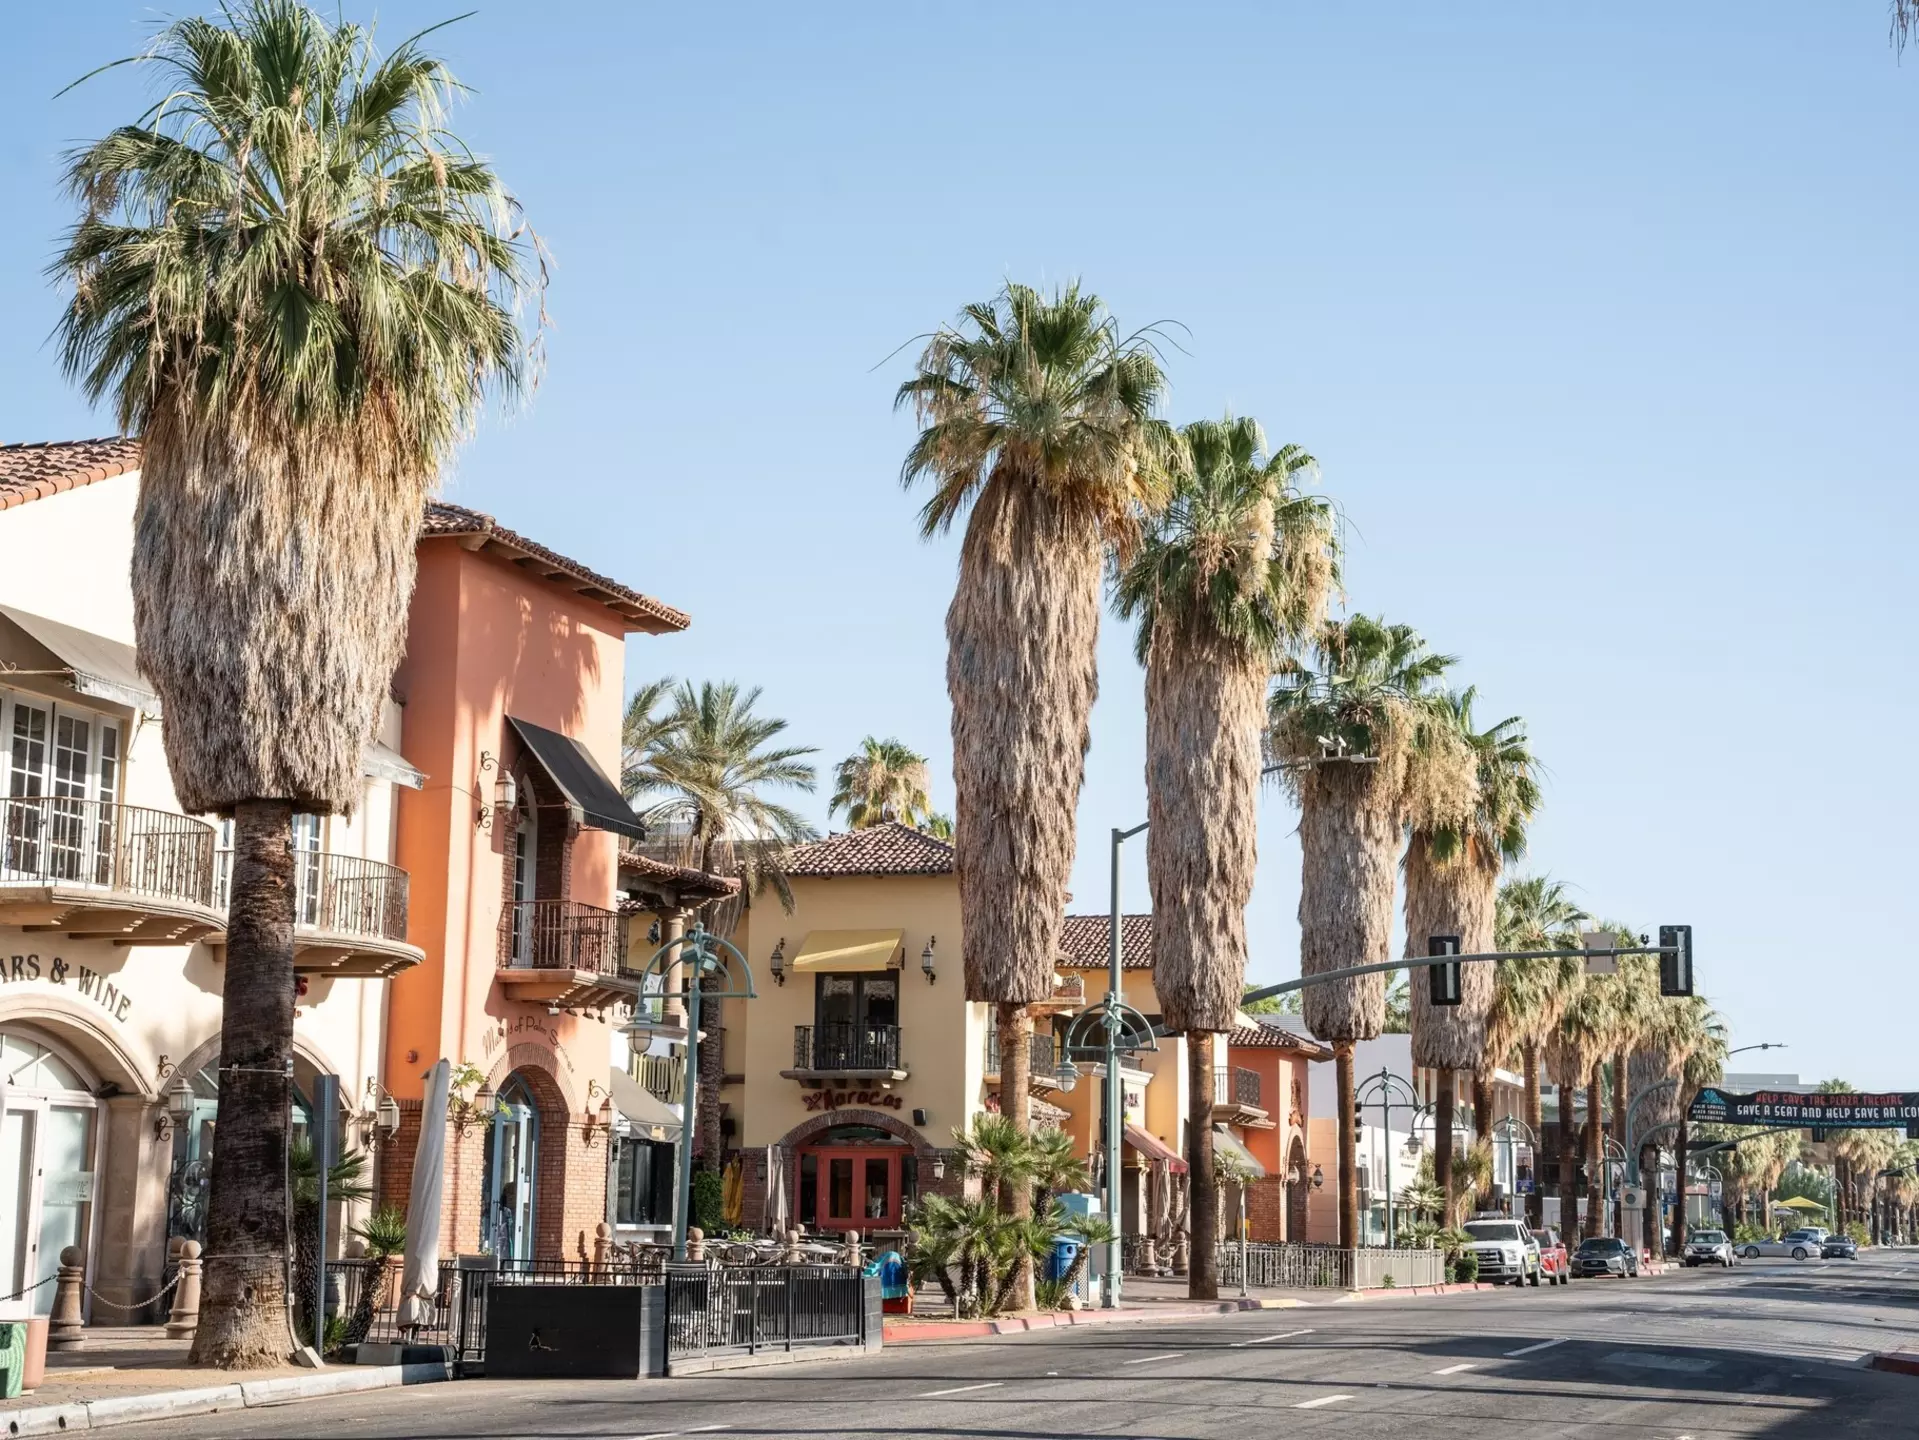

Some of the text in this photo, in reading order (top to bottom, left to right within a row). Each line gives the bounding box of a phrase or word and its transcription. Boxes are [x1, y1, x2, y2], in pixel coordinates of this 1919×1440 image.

[50, 957, 69, 985] &
[78, 965, 132, 1023] WINE
[514, 1016, 523, 1034] of
[526, 1015, 548, 1035] Palm
[1756, 1093, 1903, 1106] HELP SAVE THE PLAZA THEATRE
[1737, 1104, 1760, 1115] SAVE
[1764, 1104, 1770, 1116] A
[1774, 1105, 1798, 1117] SEAT
[1802, 1106, 1821, 1118] AND
[1826, 1106, 1851, 1118] HELP
[1855, 1106, 1879, 1118] SAVE
[1883, 1106, 1896, 1118] AN
